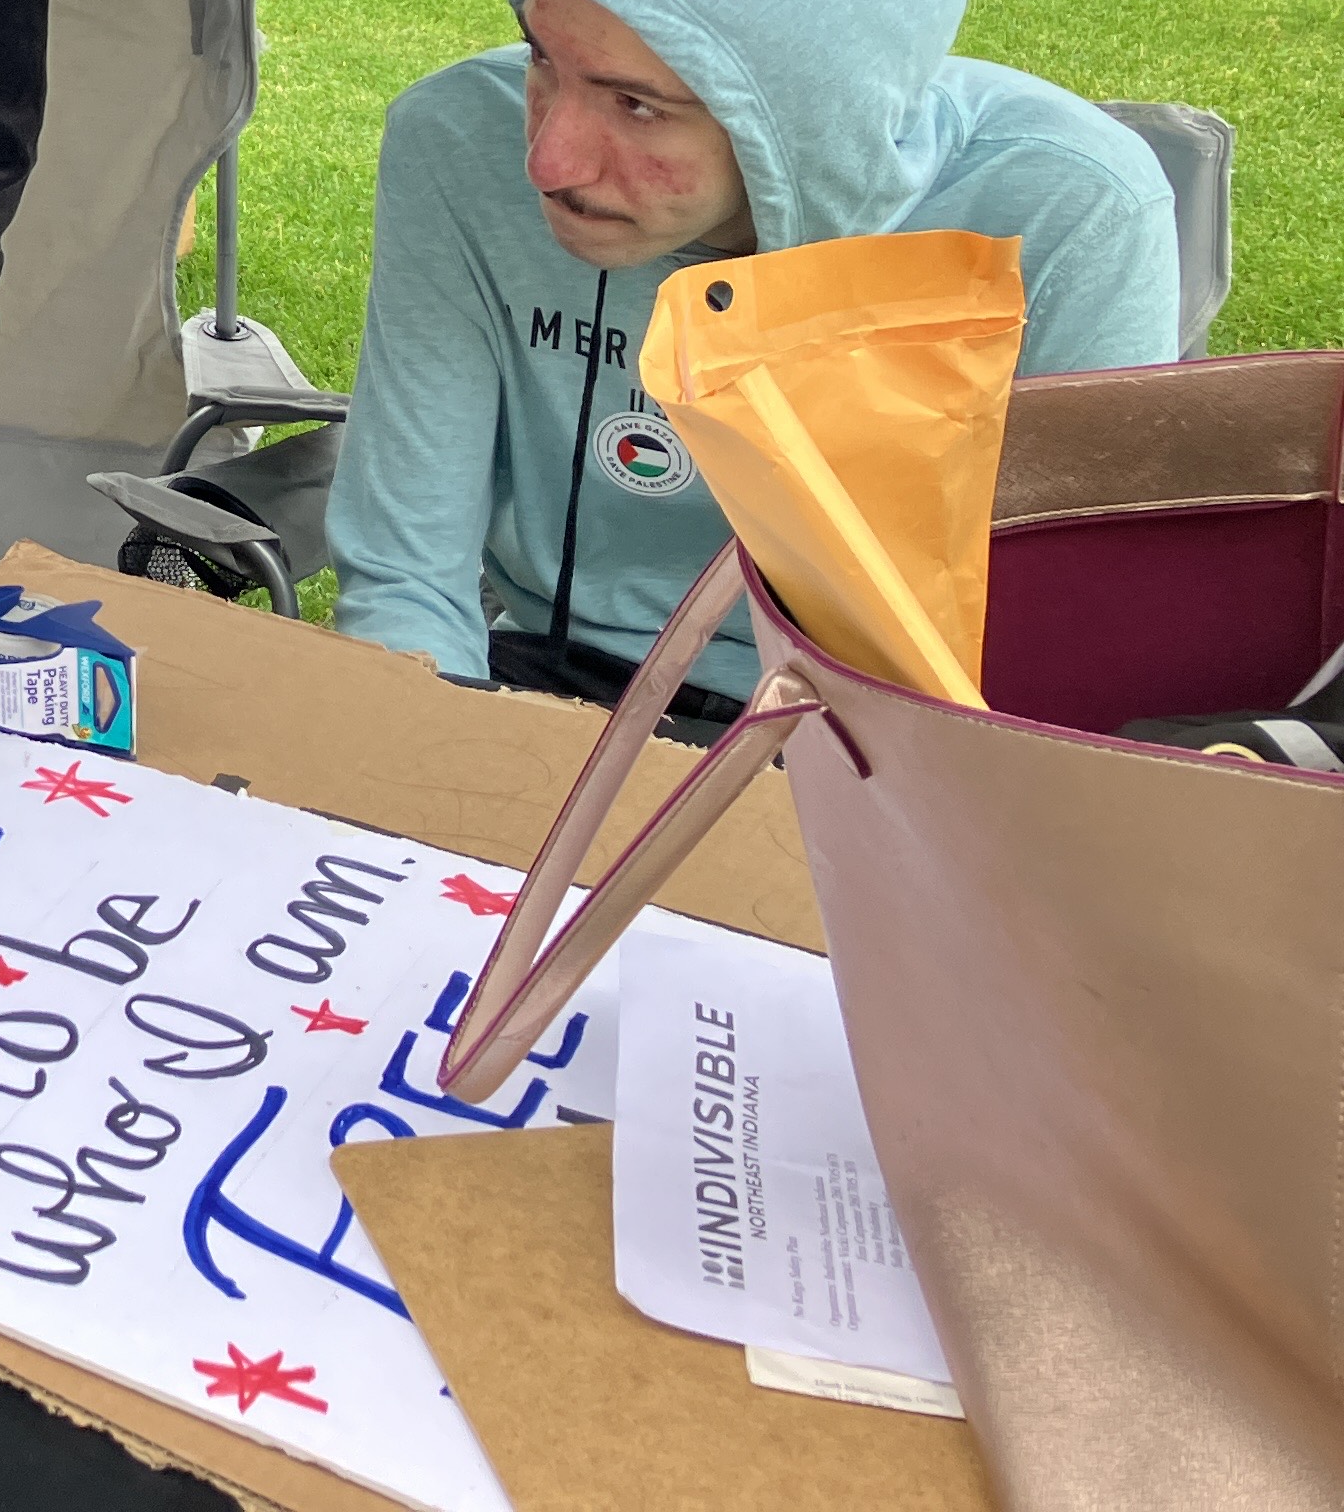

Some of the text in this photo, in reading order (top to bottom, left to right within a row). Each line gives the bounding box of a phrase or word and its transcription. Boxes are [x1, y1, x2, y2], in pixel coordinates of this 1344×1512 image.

[614, 422, 673, 444] SAVE GAZA
[606, 455, 682, 489] SAVE PALESTINE
[24, 669, 41, 705] Tape
[42, 668, 57, 727] Packing
[59, 665, 69, 728] HEAVY DUTY
[80, 656, 90, 704] WEXFORD
[124, 993, 274, 1080] I
[693, 1000, 743, 1251] INDIVISIBLE
[742, 1074, 768, 1241] NORTHEAST INDIANA
